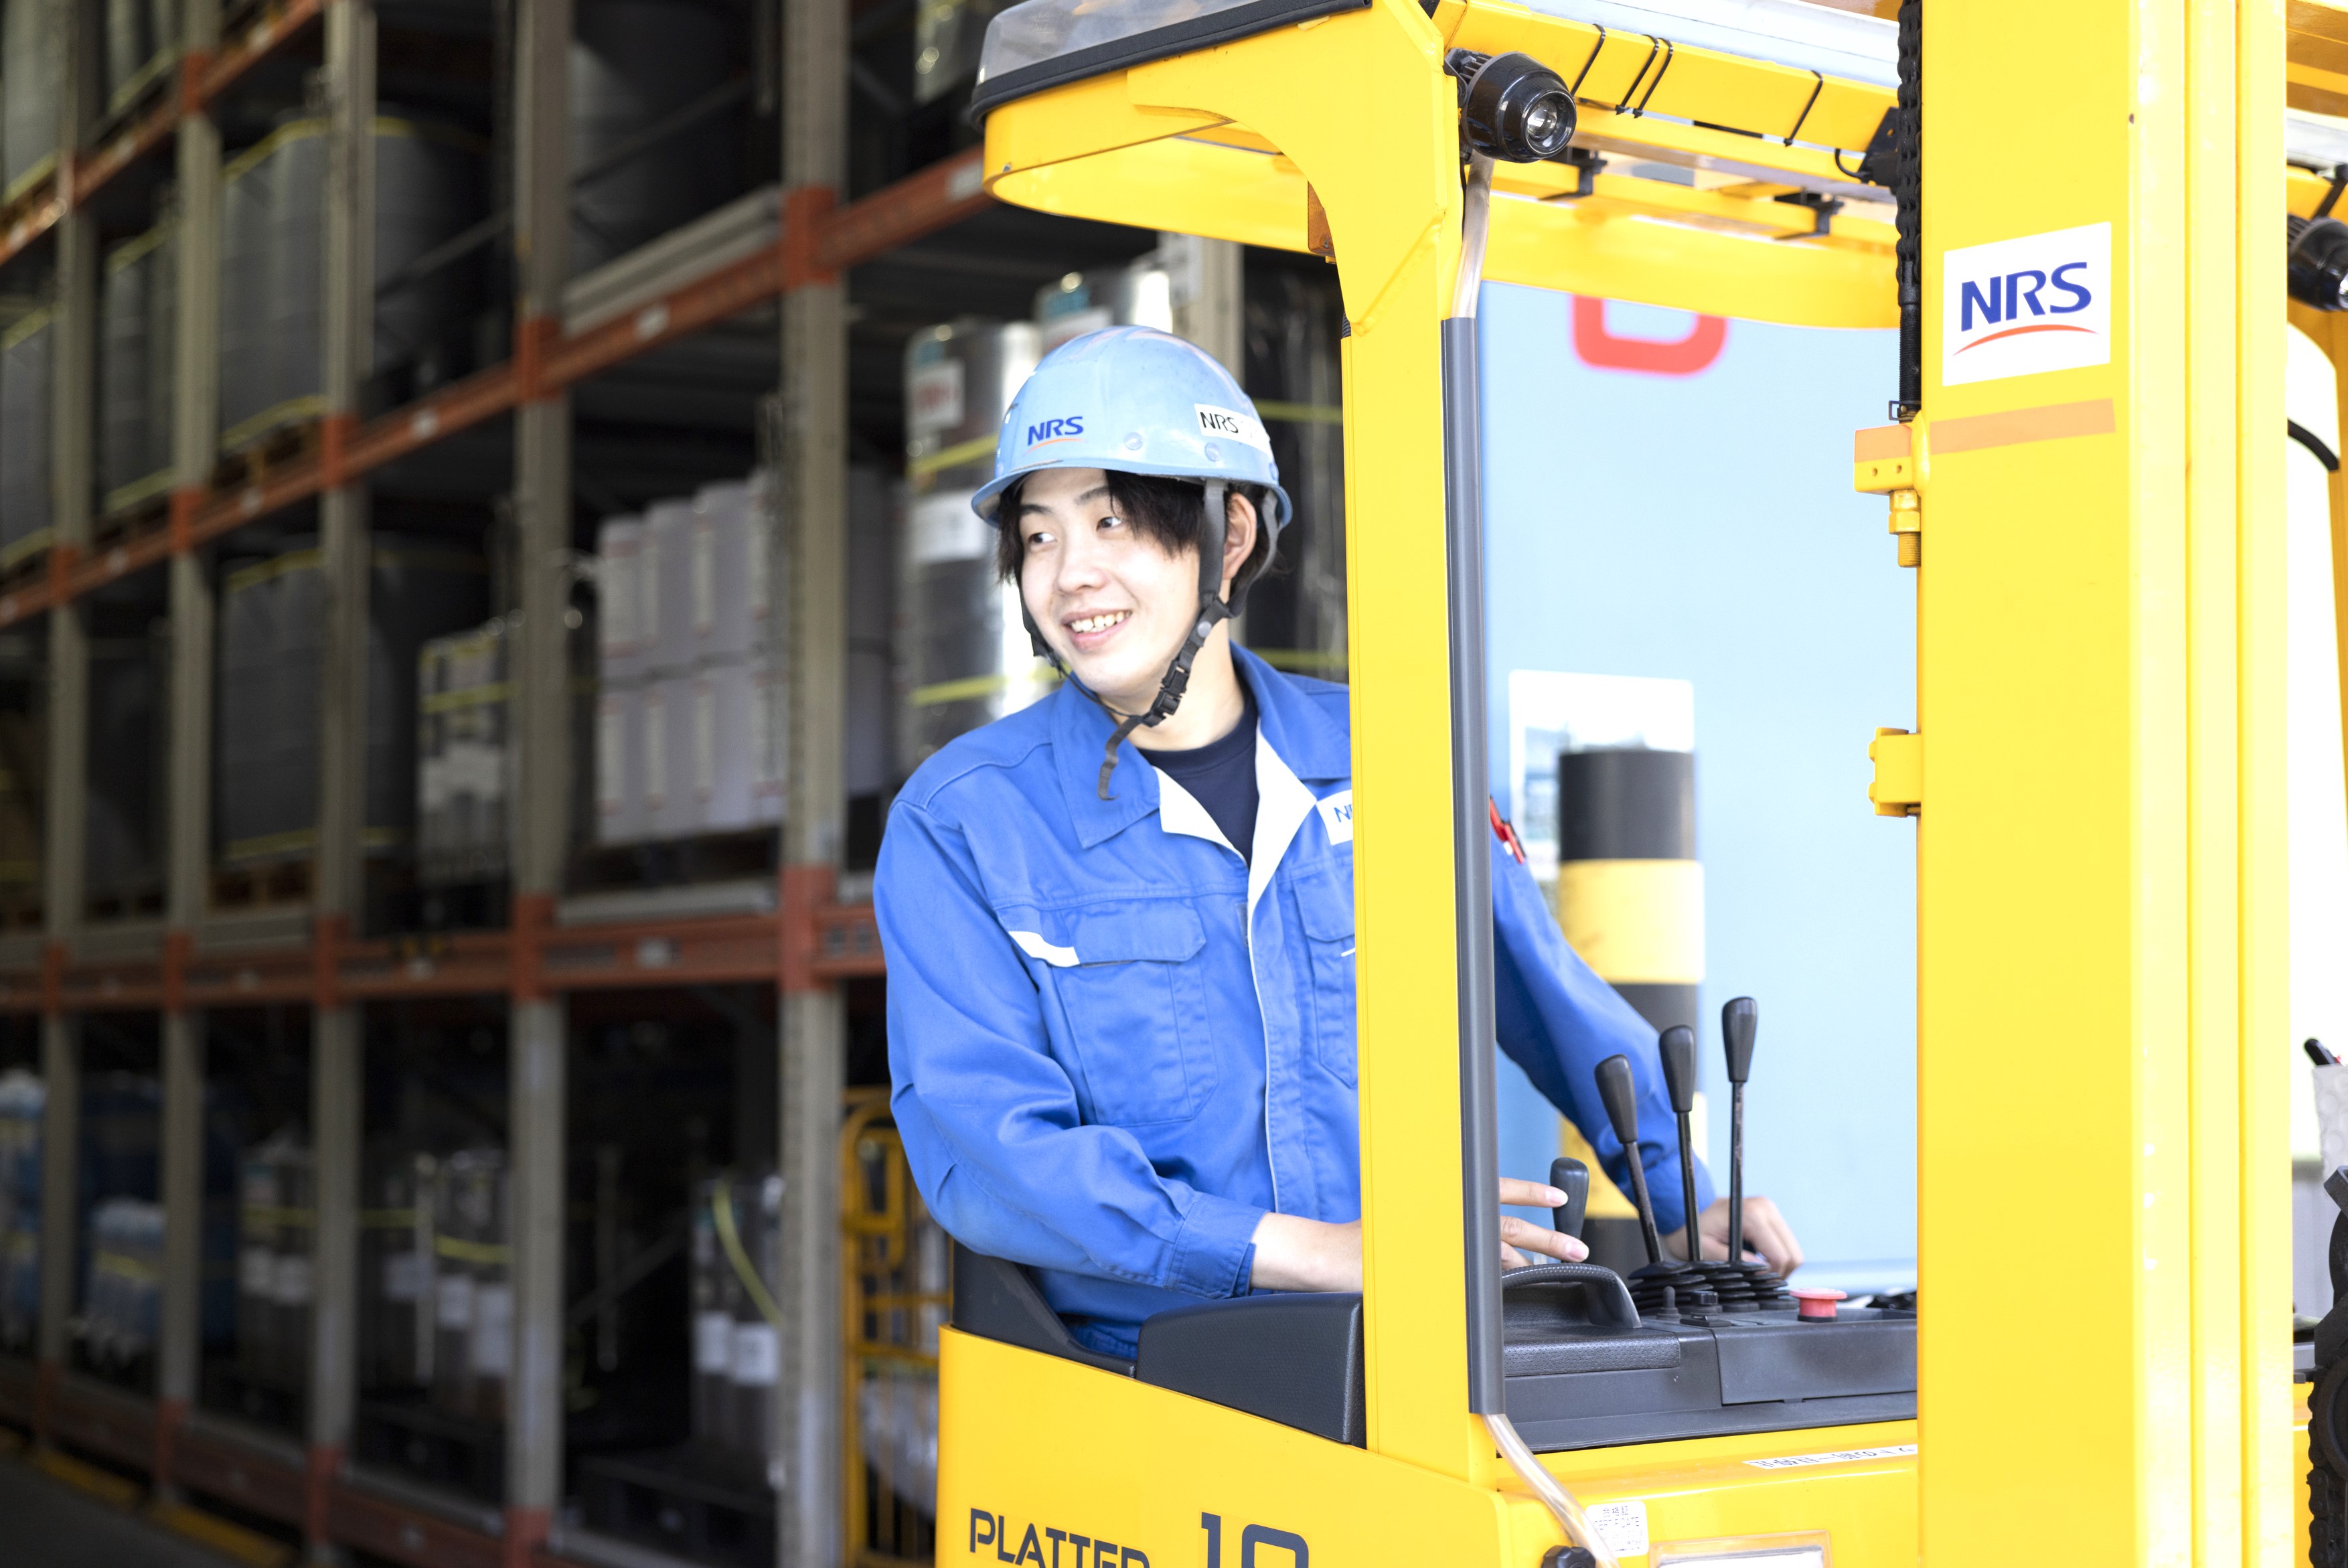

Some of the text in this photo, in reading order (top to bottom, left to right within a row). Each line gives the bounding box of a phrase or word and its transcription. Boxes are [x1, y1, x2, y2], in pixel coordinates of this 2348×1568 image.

[1960, 261, 2092, 332] NRS
[1028, 416, 1083, 446] NRS
[1200, 411, 1239, 434] NRS
[1334, 803, 1352, 823] N
